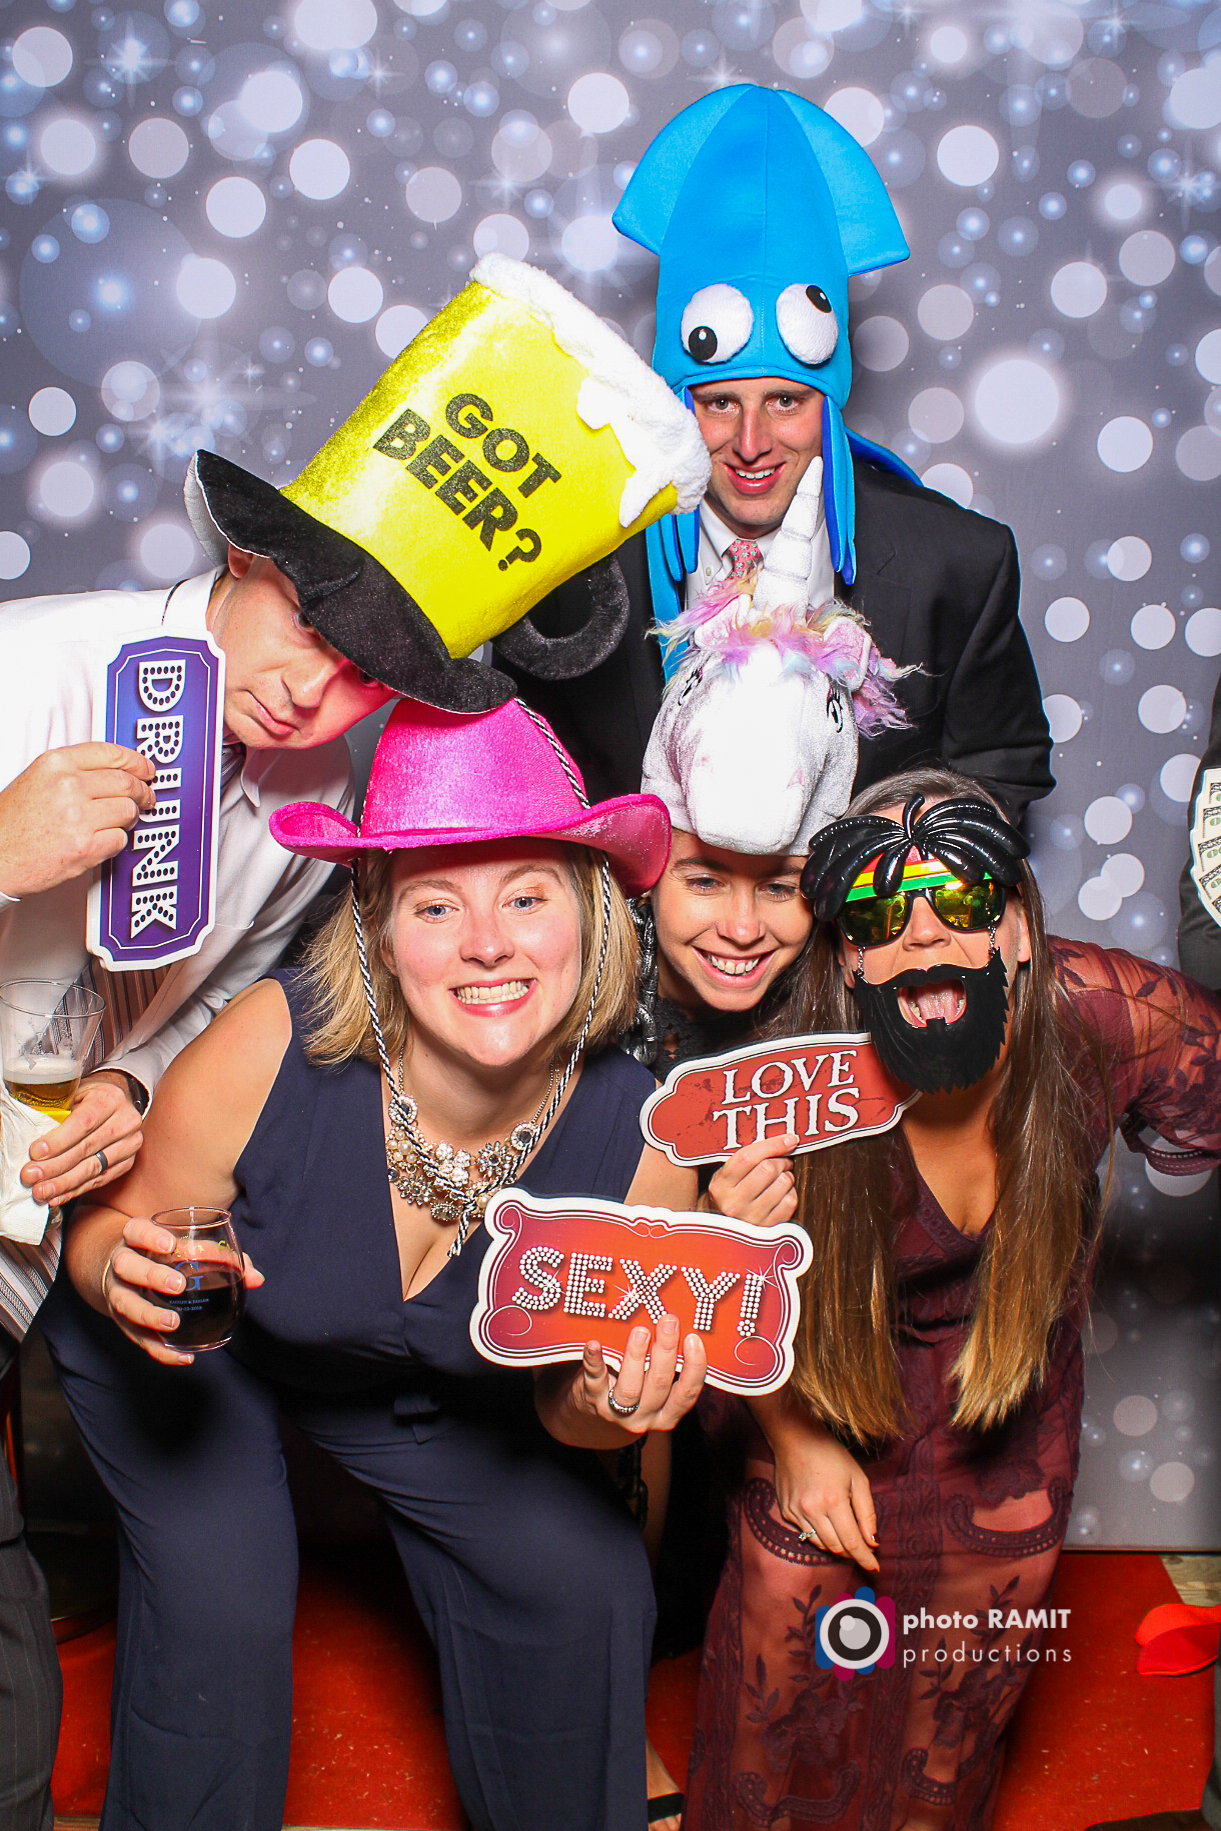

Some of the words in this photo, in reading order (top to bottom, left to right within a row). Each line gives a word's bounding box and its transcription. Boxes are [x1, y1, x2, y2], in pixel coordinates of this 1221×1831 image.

[373, 408, 542, 571] BEER?
[445, 393, 562, 498] GOT
[713, 1087, 860, 1150] THIS
[721, 1050, 857, 1105] LOVE
[512, 1246, 764, 1337] SEXY!
